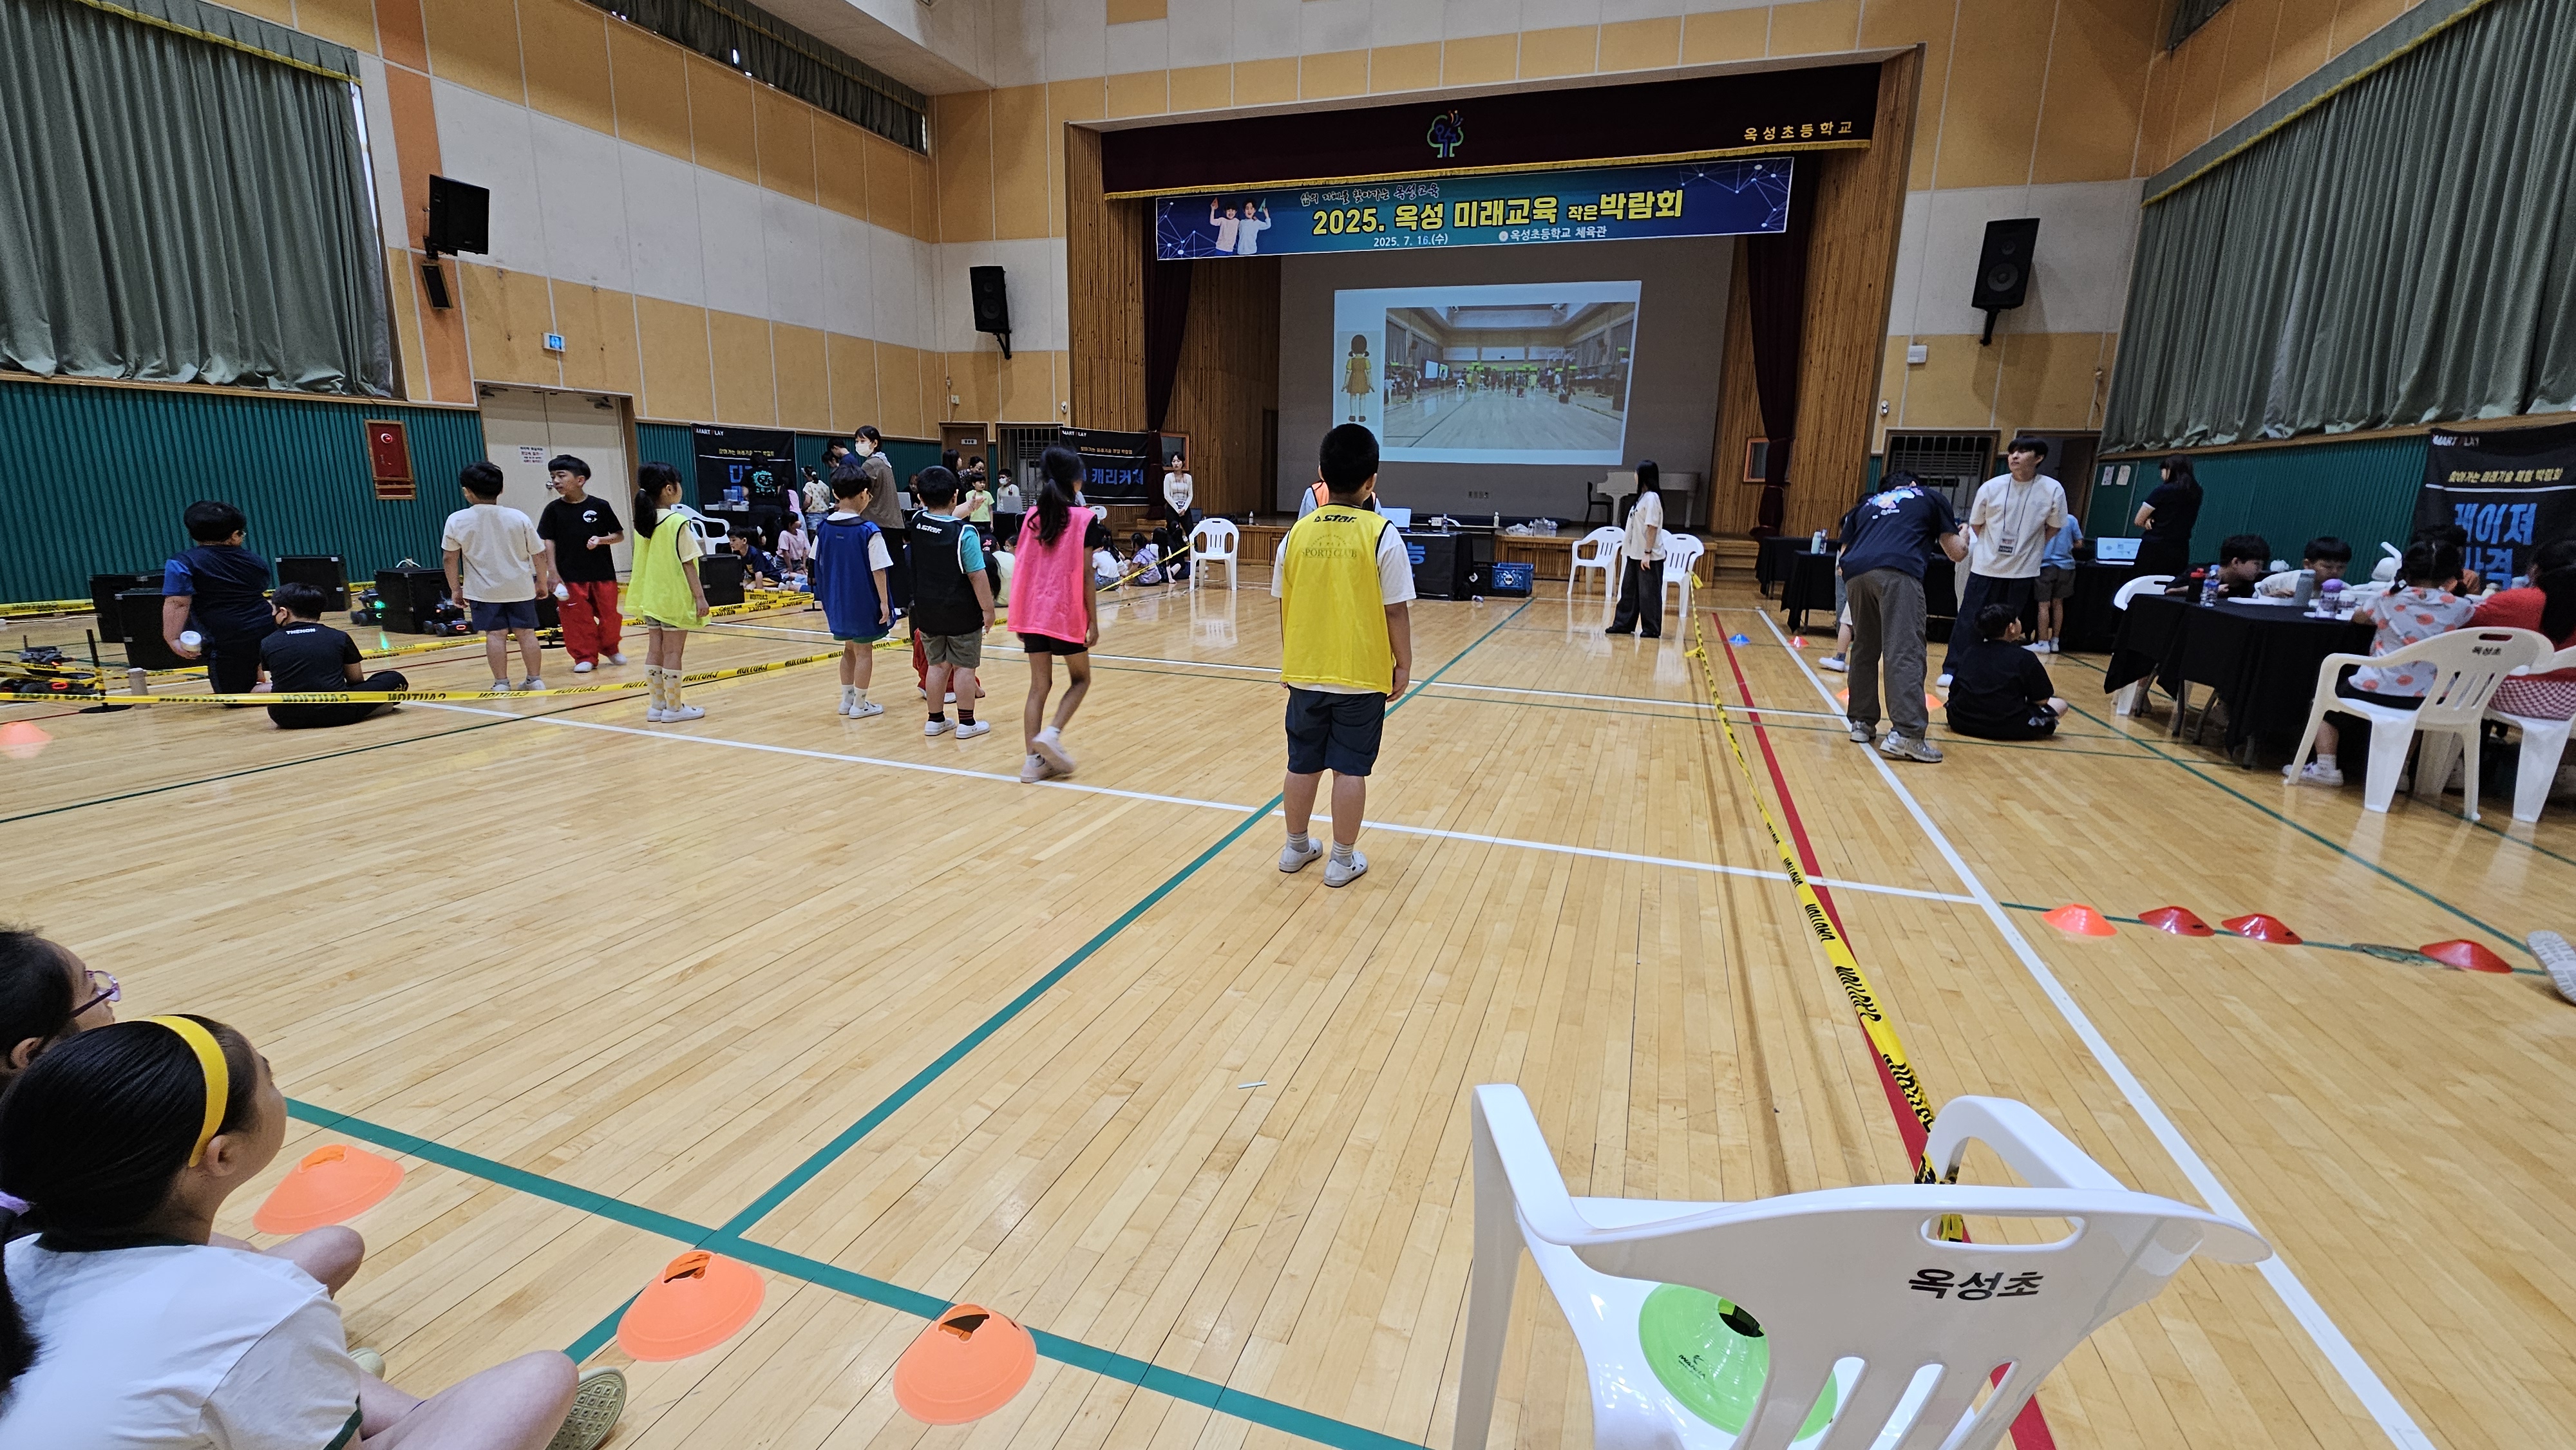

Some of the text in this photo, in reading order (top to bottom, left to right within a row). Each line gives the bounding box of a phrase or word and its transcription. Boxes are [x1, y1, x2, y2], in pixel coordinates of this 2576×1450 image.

[1744, 121, 1852, 142] 옥성초등학교
[1353, 188, 1390, 203] 찾아가는
[1393, 183, 1440, 200] 옥성교육
[1312, 208, 1385, 235] 2025.
[1395, 203, 1443, 231] 옥성
[1454, 197, 1557, 227] 미래교육
[1374, 233, 1448, 247] 2025. 7. 16.(수)
[1510, 225, 1607, 241] 옥성초등학교 체육관
[1908, 1268, 2045, 1301] 옥성초
